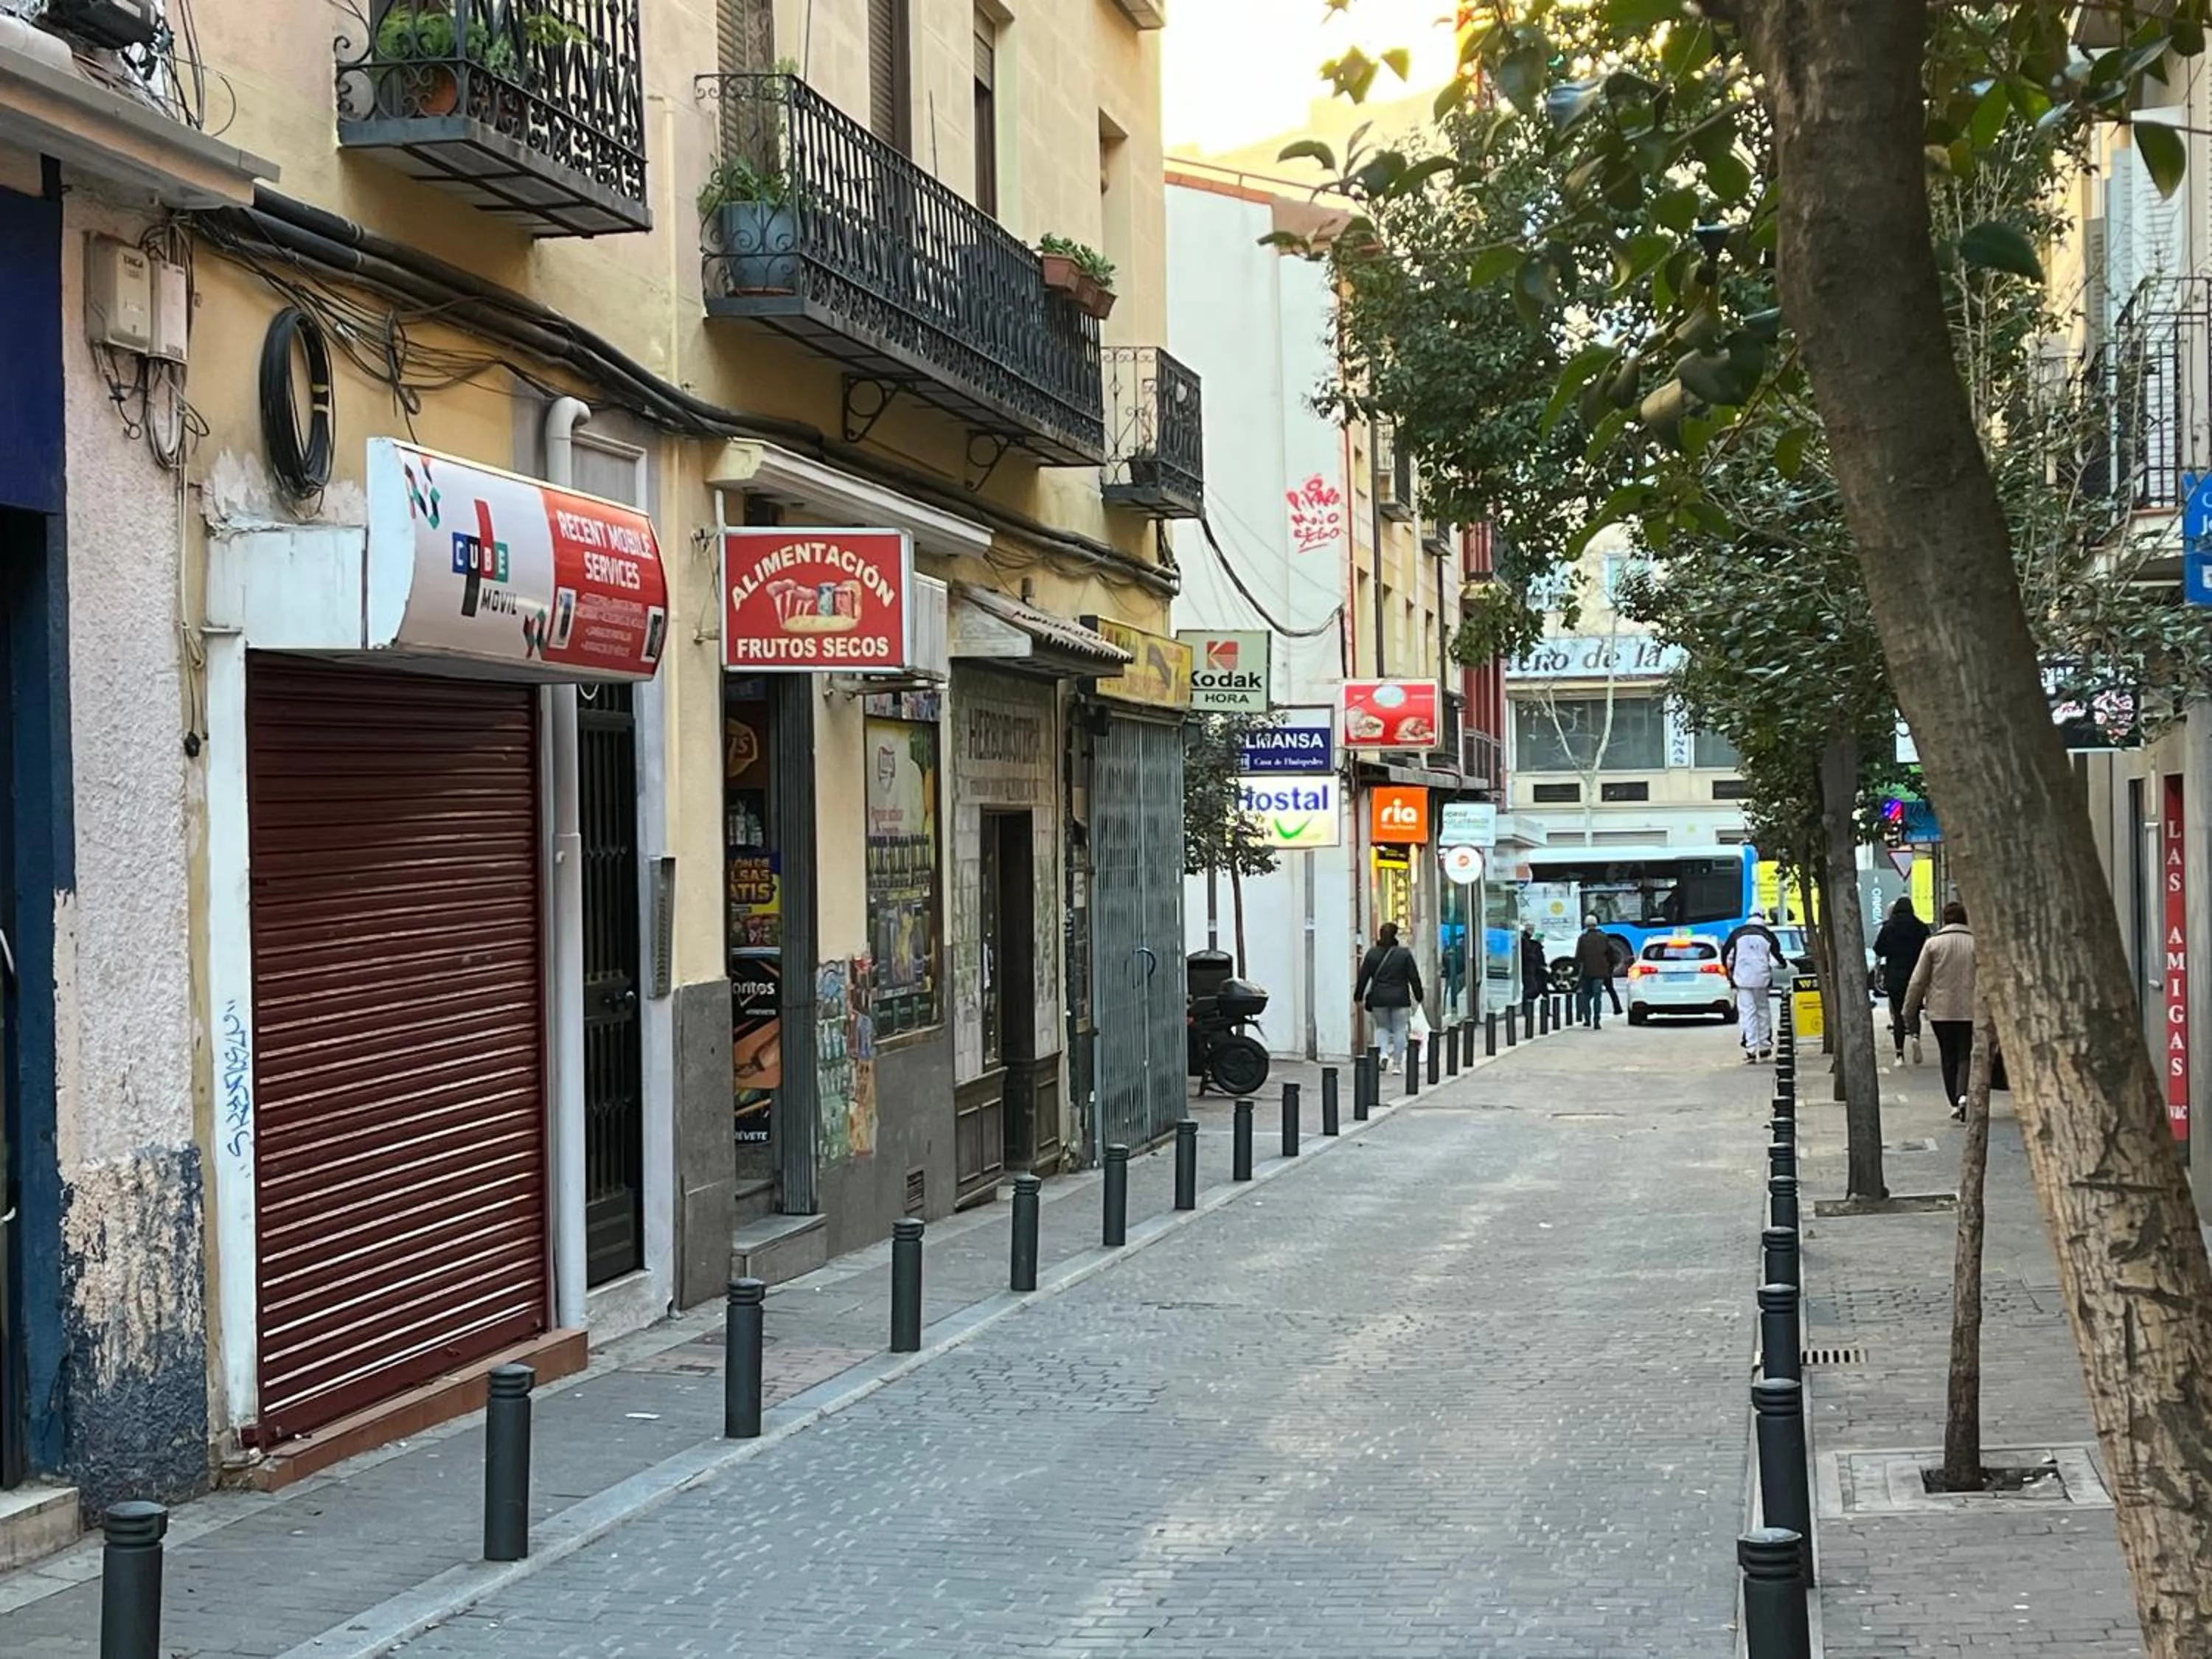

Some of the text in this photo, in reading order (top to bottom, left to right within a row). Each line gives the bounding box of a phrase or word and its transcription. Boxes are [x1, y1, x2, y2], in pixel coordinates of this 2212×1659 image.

[556, 509, 654, 560] RECENT MOBILE
[456, 540, 505, 574] CUBE
[583, 551, 640, 590] SERVICES
[731, 542, 895, 611] ALIMENTACIÓN
[481, 588, 517, 615] MOVIL
[737, 636, 888, 658] FRUTOS SECOS
[1583, 638, 1620, 668] de
[1191, 671, 1262, 688] Kodak
[1204, 693, 1250, 703] HORA
[1253, 757, 1272, 766] Casa
[1236, 784, 1329, 811] Hostal
[1380, 798, 1417, 824] ria
[1871, 887, 1882, 925] VIDRIO
[2166, 819, 2185, 1077] LAS AMIGAS
[732, 981, 775, 995] oritos
